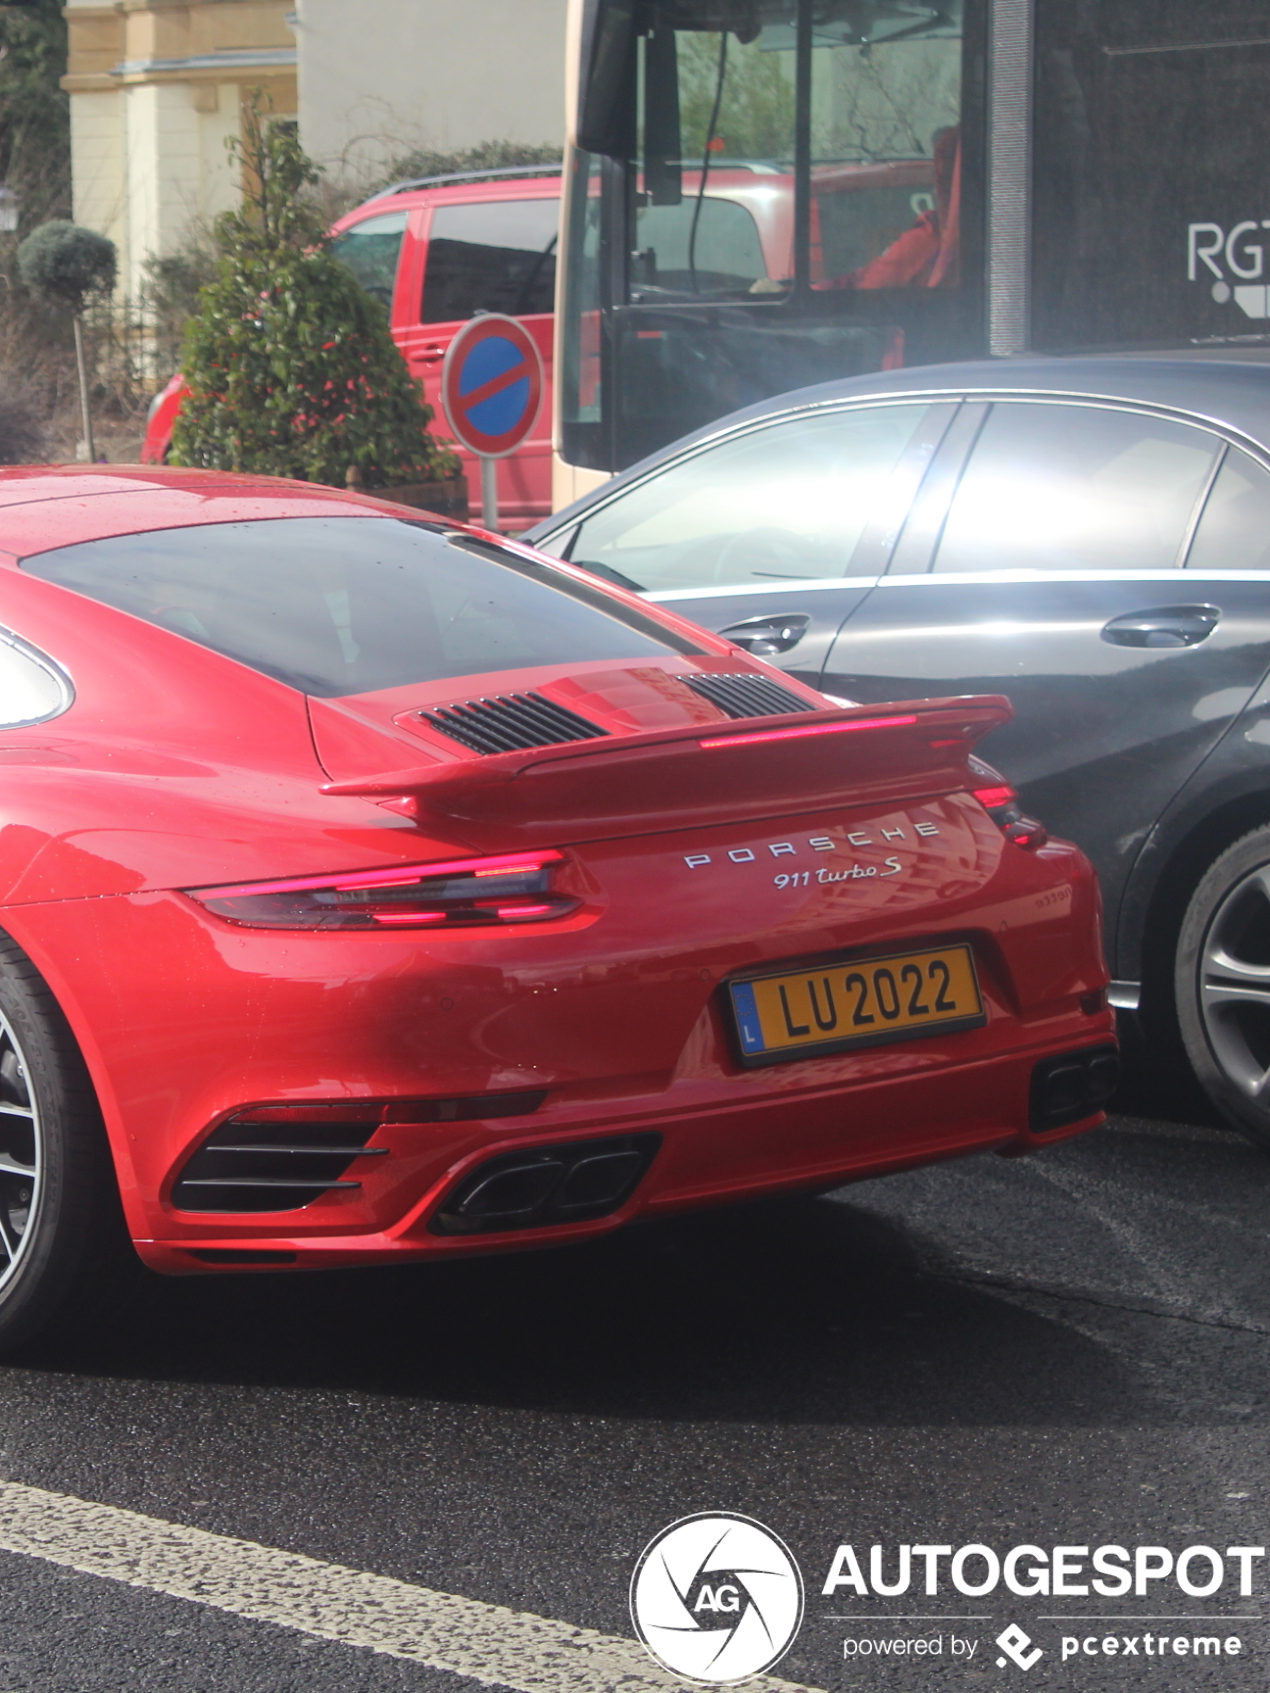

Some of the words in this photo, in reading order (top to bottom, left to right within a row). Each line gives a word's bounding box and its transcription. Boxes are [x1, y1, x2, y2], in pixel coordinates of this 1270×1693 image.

[1187, 220, 1270, 281] RG
[683, 821, 940, 870] PORSCHE
[773, 870, 810, 890] 911
[815, 863, 878, 884] turbo
[880, 855, 903, 877] S
[743, 1024, 756, 1043] L
